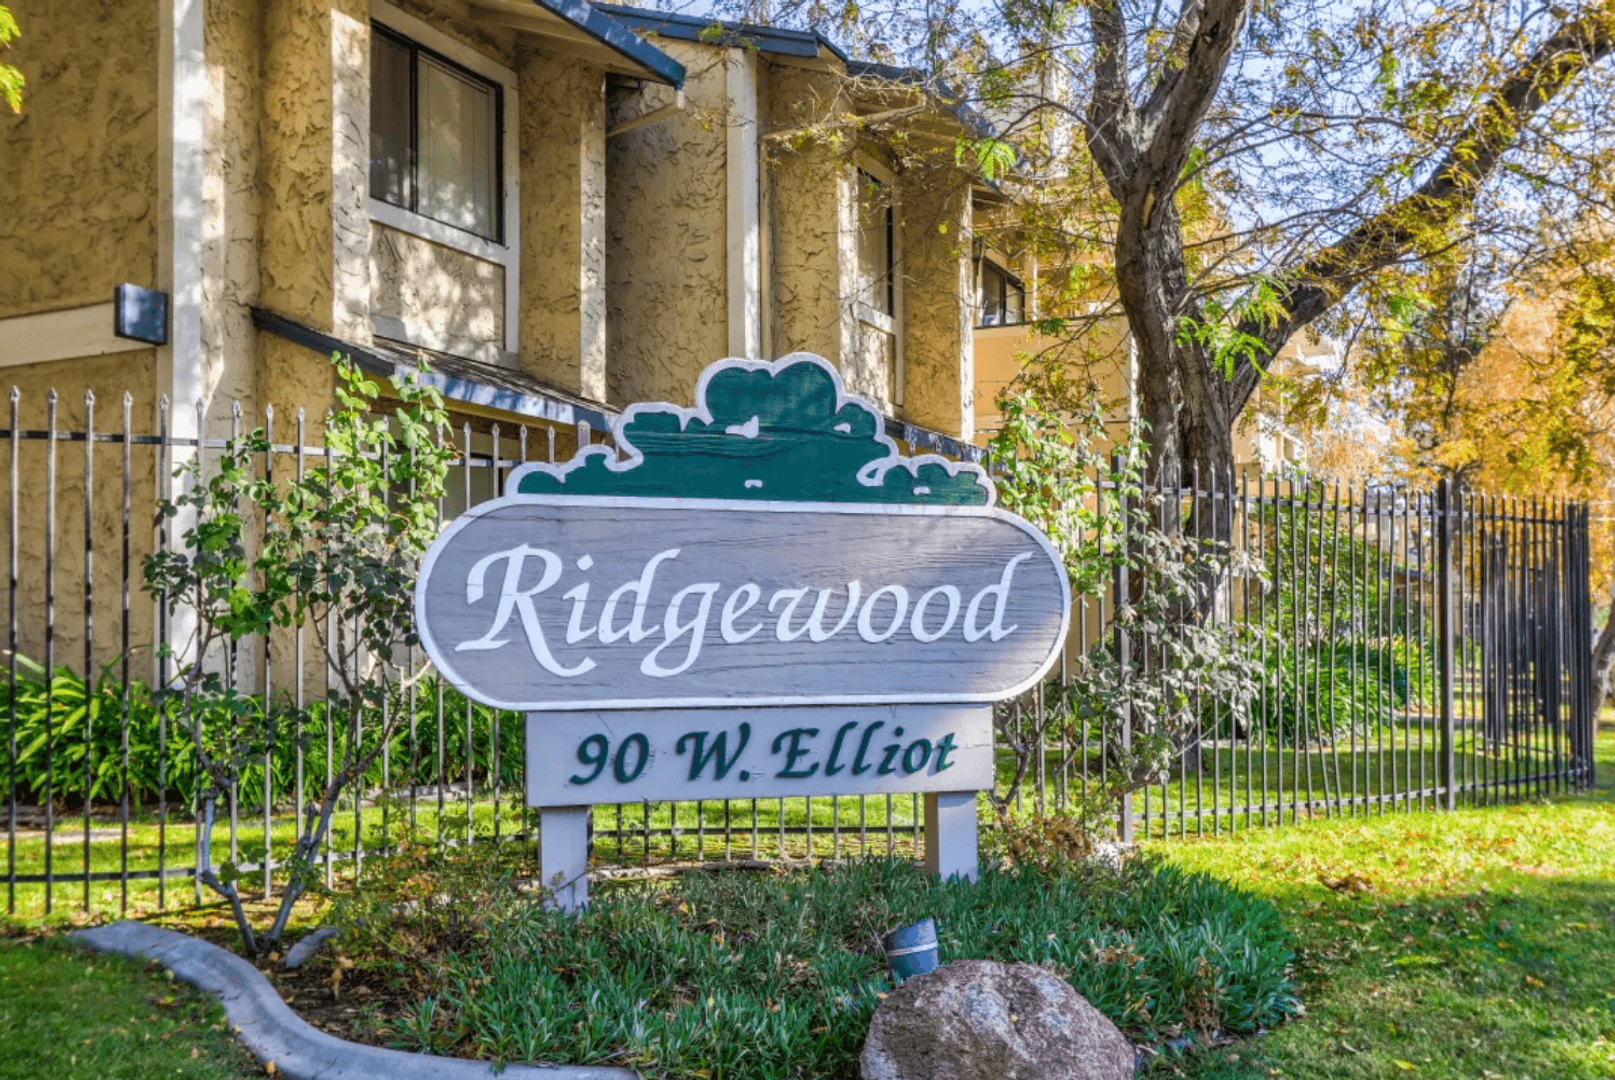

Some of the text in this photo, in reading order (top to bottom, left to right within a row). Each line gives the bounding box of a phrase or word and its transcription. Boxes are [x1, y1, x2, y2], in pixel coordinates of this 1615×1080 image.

[455, 542, 1033, 679] Ridgewood
[569, 720, 958, 786] 90 W. Elliot
